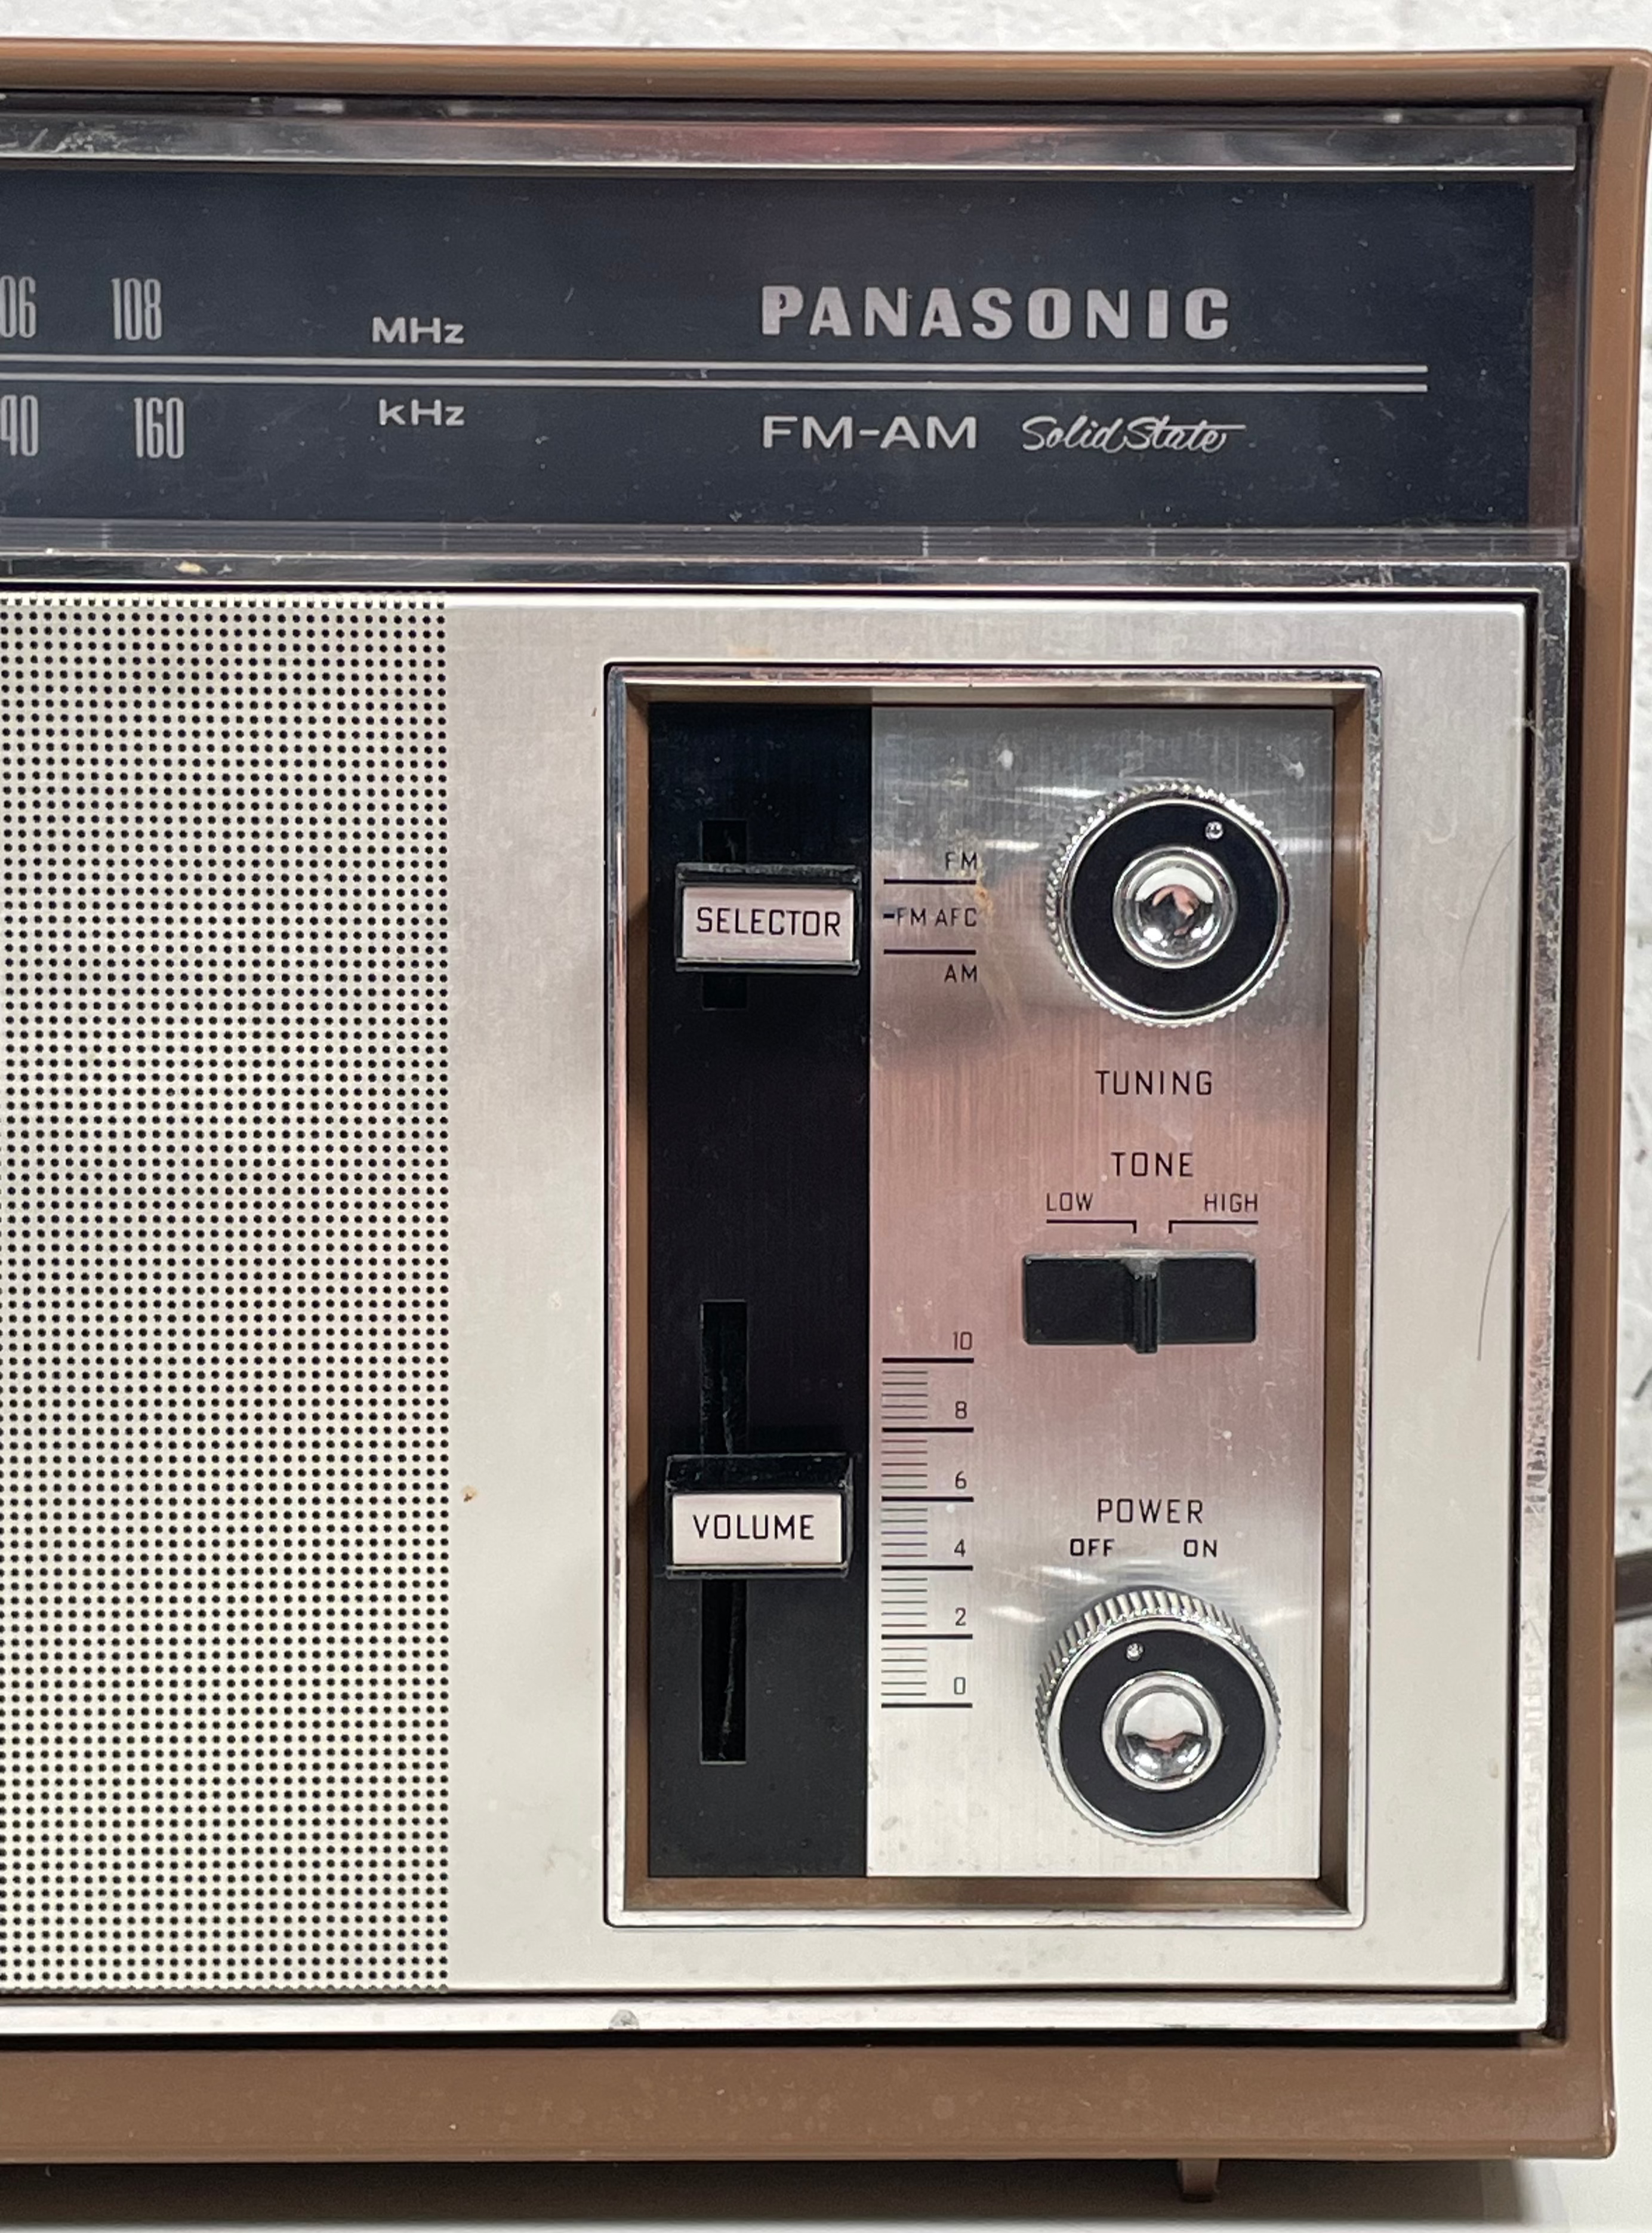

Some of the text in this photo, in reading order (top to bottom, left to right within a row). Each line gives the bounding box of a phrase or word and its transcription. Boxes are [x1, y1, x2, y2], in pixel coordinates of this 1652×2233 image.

[111, 278, 162, 340] 108
[371, 316, 464, 344] MHz
[761, 285, 1229, 340] PANASONIC
[133, 397, 184, 458] 160
[379, 399, 465, 426] kHz
[762, 415, 976, 449] FM-AM
[1022, 415, 1246, 454] Solid State
[945, 852, 978, 871] FM
[696, 906, 841, 937] SELECTOR
[934, 907, 978, 927] AFC
[944, 965, 978, 983] AM
[1095, 1070, 1213, 1096] TUNING
[1111, 1152, 1194, 1177] TONE
[1046, 1193, 1258, 1213] LOW HIGH
[953, 1331, 973, 1350] 10
[954, 1401, 967, 1419] 8
[955, 1471, 967, 1489] 6
[1097, 1498, 1203, 1524] POWER
[692, 1514, 815, 1540] VOLUME
[954, 1538, 966, 1557] 4
[1070, 1538, 1218, 1557] OFF ON
[954, 1607, 966, 1627] 2
[954, 1677, 966, 1695] 0
